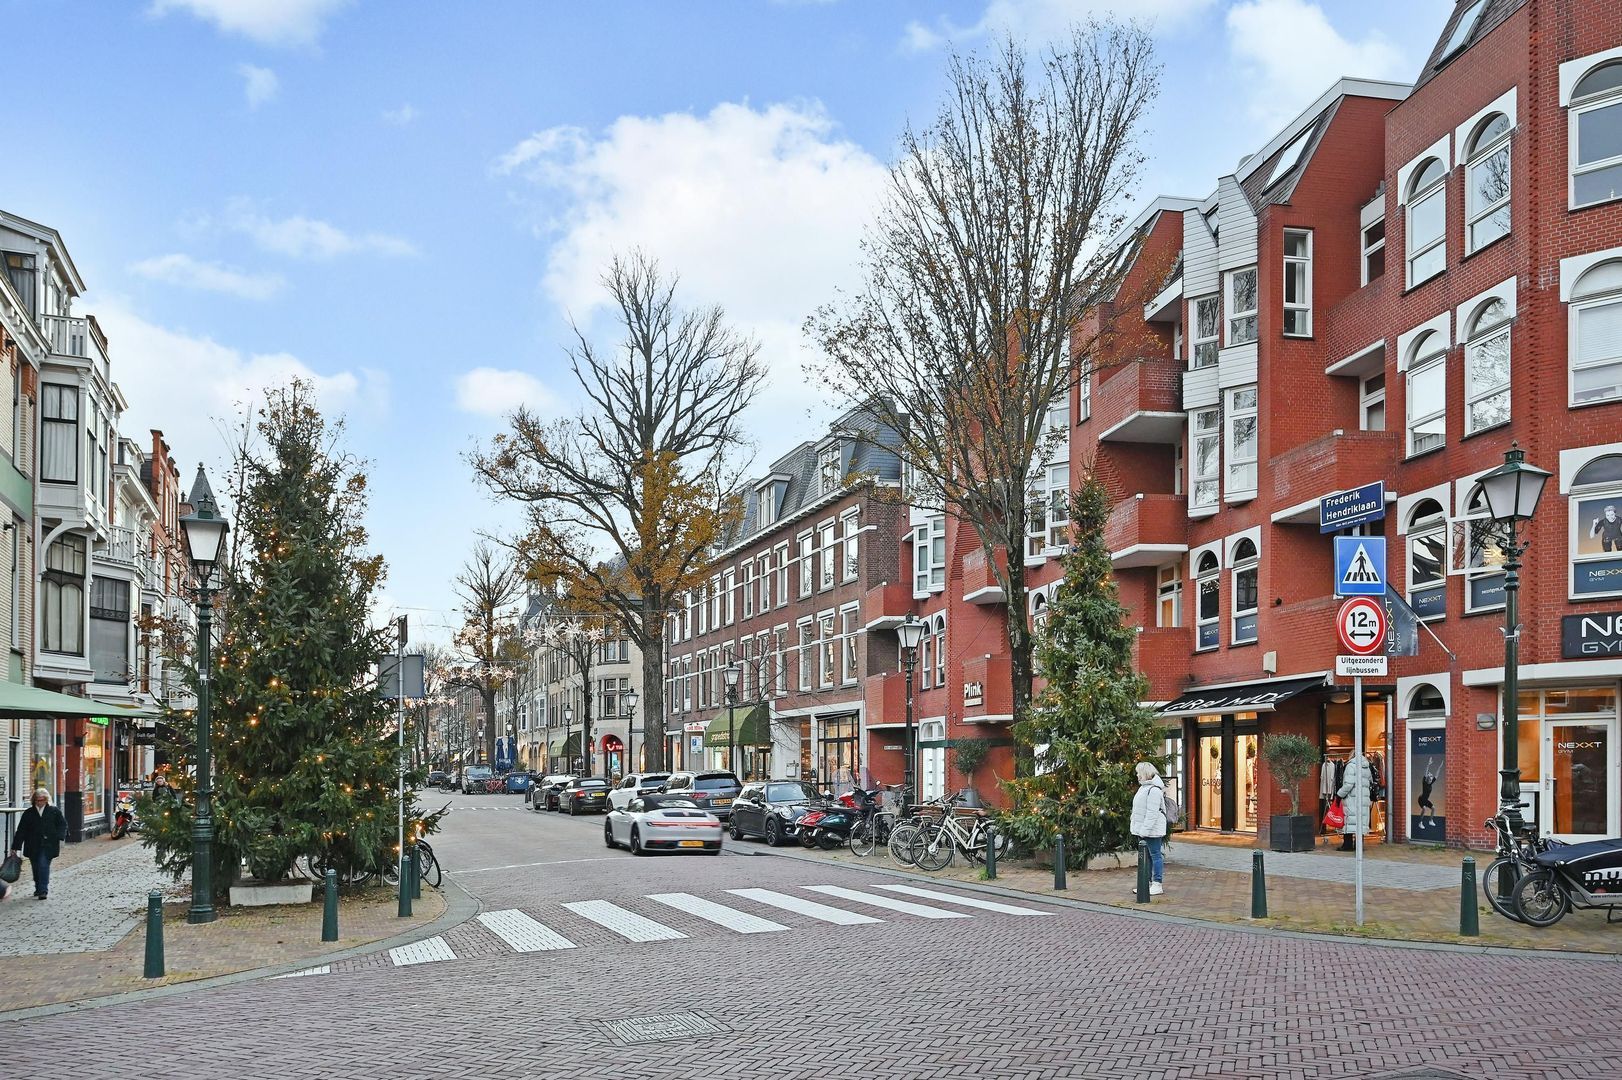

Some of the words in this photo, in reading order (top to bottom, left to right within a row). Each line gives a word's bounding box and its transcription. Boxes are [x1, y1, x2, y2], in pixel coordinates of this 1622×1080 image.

[1326, 491, 1361, 508] Frederik
[1326, 501, 1376, 520] Hendriklaan
[1418, 594, 1442, 604] NEXXT
[1385, 597, 1395, 653] NEXXT
[1341, 657, 1384, 665] Uitgezonderd
[1346, 667, 1379, 675] lijnbussen
[964, 681, 982, 698] Plink
[1558, 741, 1602, 749] NEXXT
